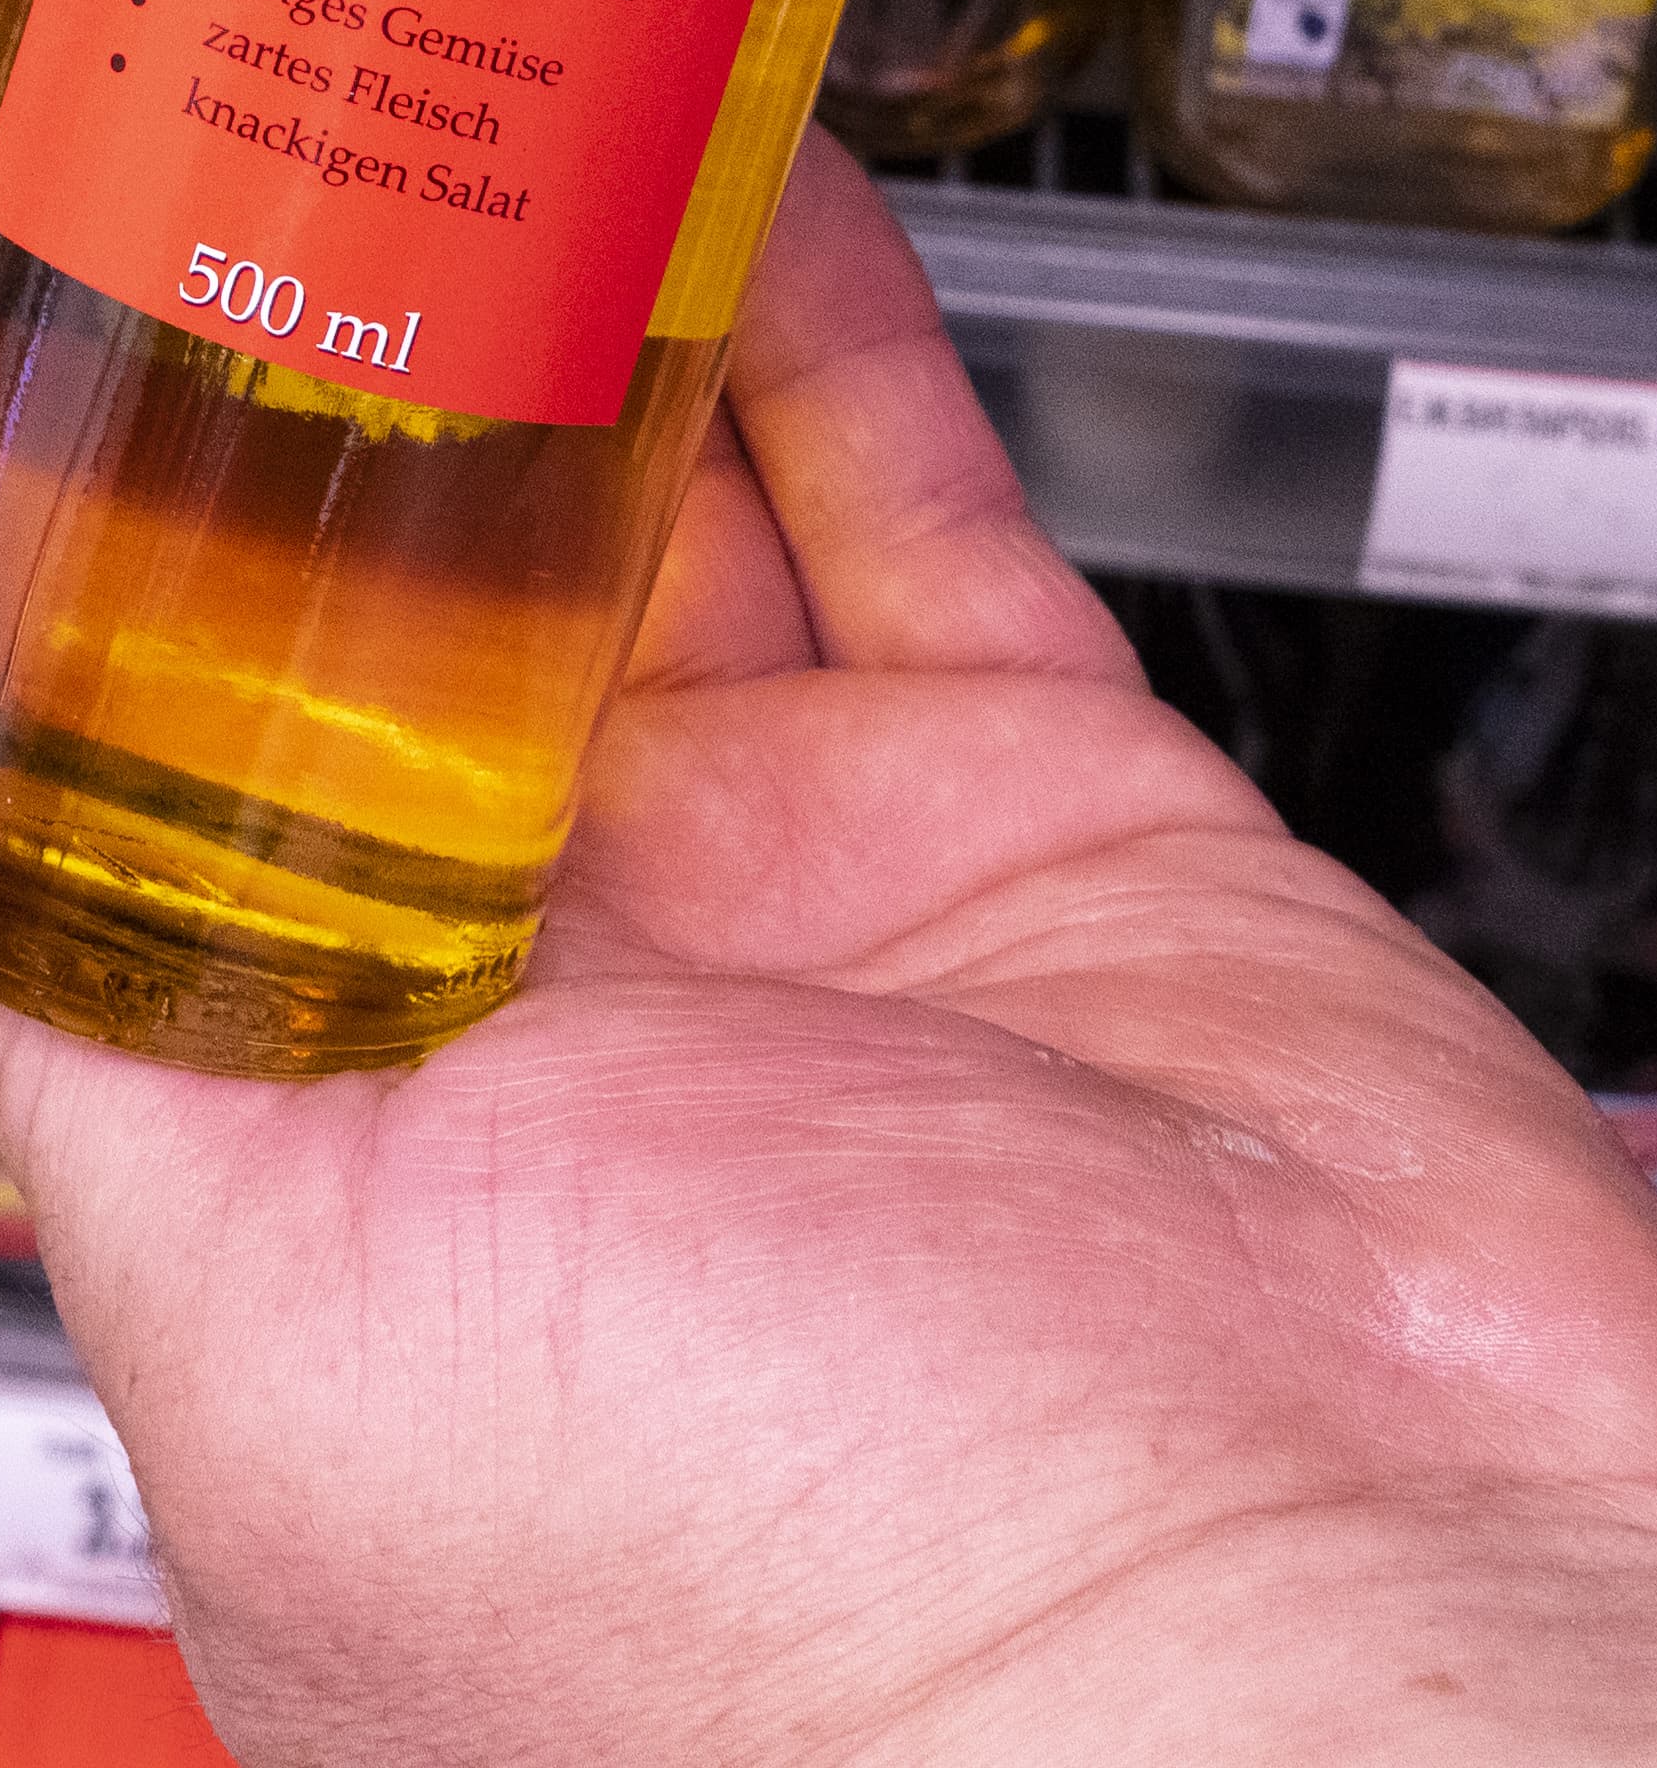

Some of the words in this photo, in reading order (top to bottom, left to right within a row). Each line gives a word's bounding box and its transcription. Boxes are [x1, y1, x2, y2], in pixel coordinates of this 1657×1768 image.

[201, 19, 334, 96] zartes
[345, 64, 504, 147] Fleisch
[380, 5, 566, 91] Gemüse
[181, 75, 411, 188] knackigen
[419, 162, 534, 224] Salat
[177, 241, 306, 339] 500
[315, 308, 423, 376] ml
